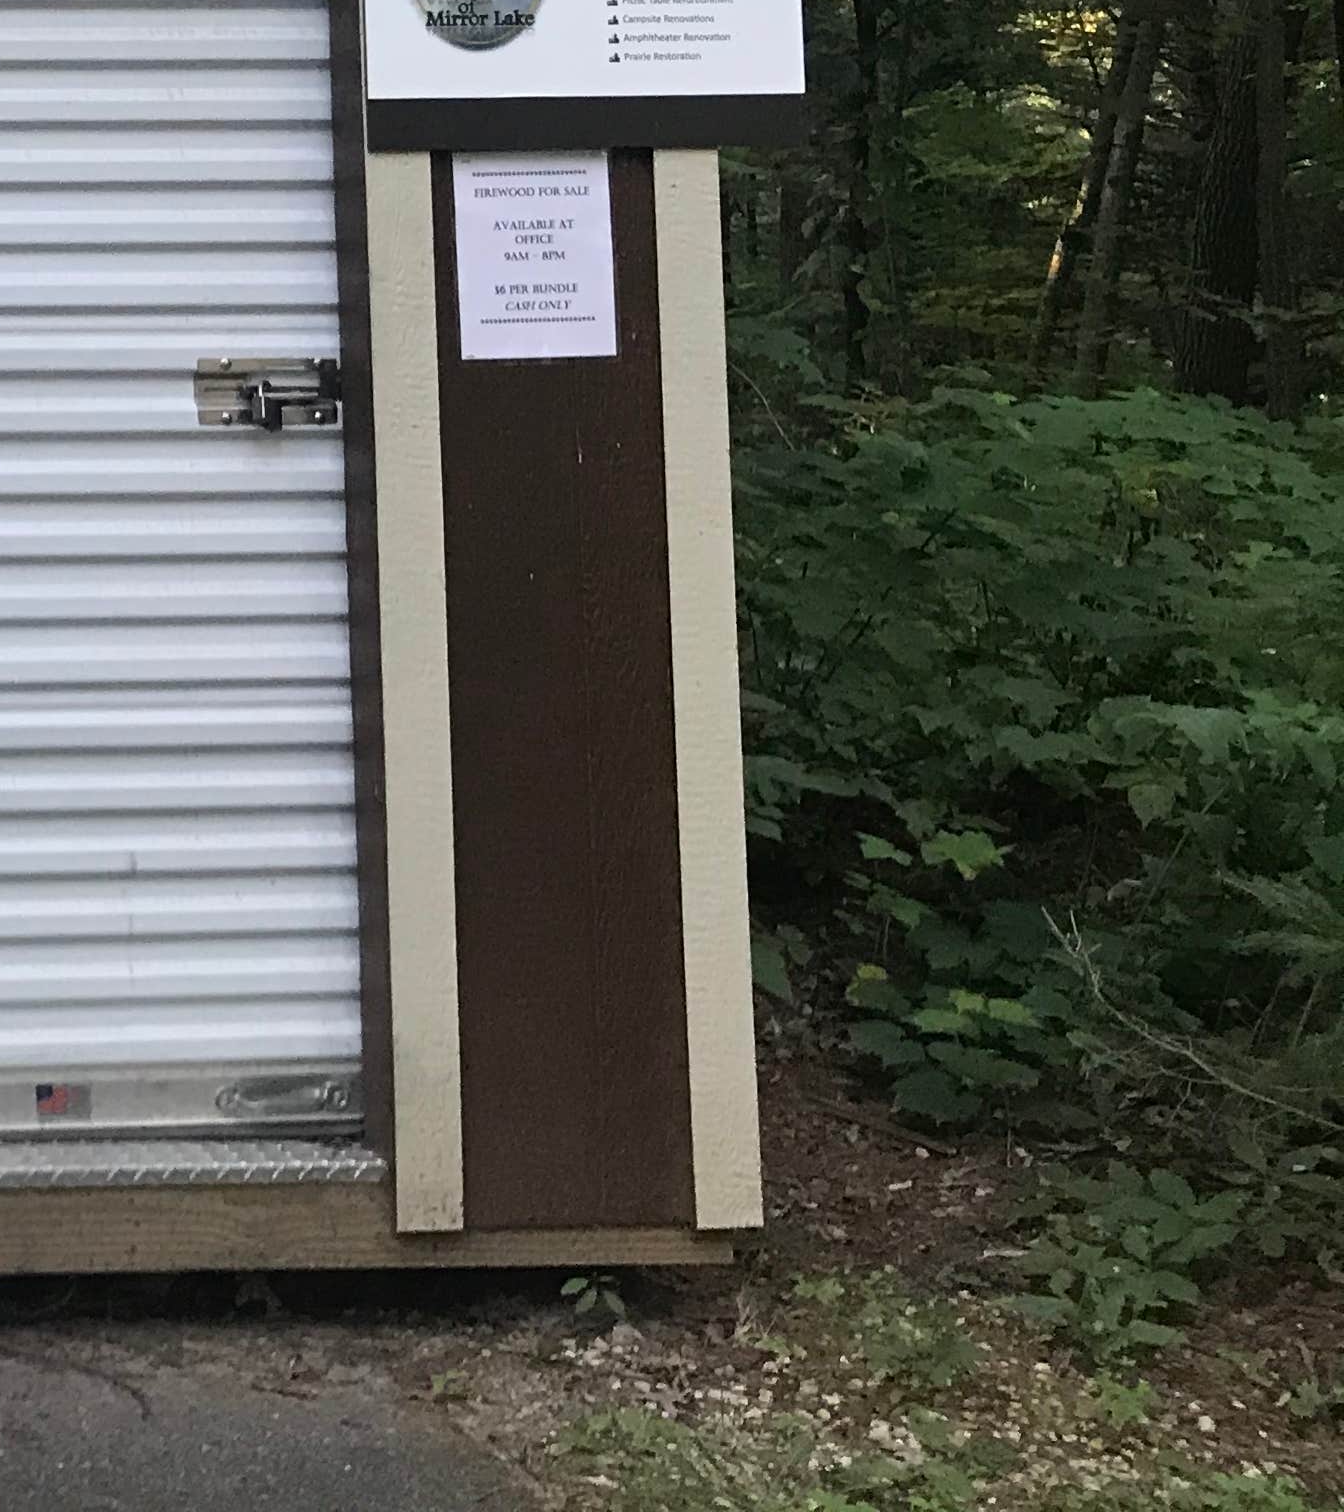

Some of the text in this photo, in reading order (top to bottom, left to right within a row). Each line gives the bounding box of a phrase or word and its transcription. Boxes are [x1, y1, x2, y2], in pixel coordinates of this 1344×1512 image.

[458, 0, 475, 14] of
[425, 9, 536, 27] Mirror Lake
[622, 14, 714, 24] Campsite Renovations
[623, 33, 731, 43] Amphitheater Renovation
[624, 51, 702, 61] Prairie Restoration
[474, 186, 590, 198] FIREWOOD FOR SALE
[493, 219, 574, 231] AVAILABLE AT
[515, 234, 554, 244] OFFICE
[504, 251, 529, 261] 9AM
[542, 250, 565, 260] 8PM
[494, 283, 579, 295] $6 PER BUNDLE
[505, 299, 572, 311] CASH ONLY
